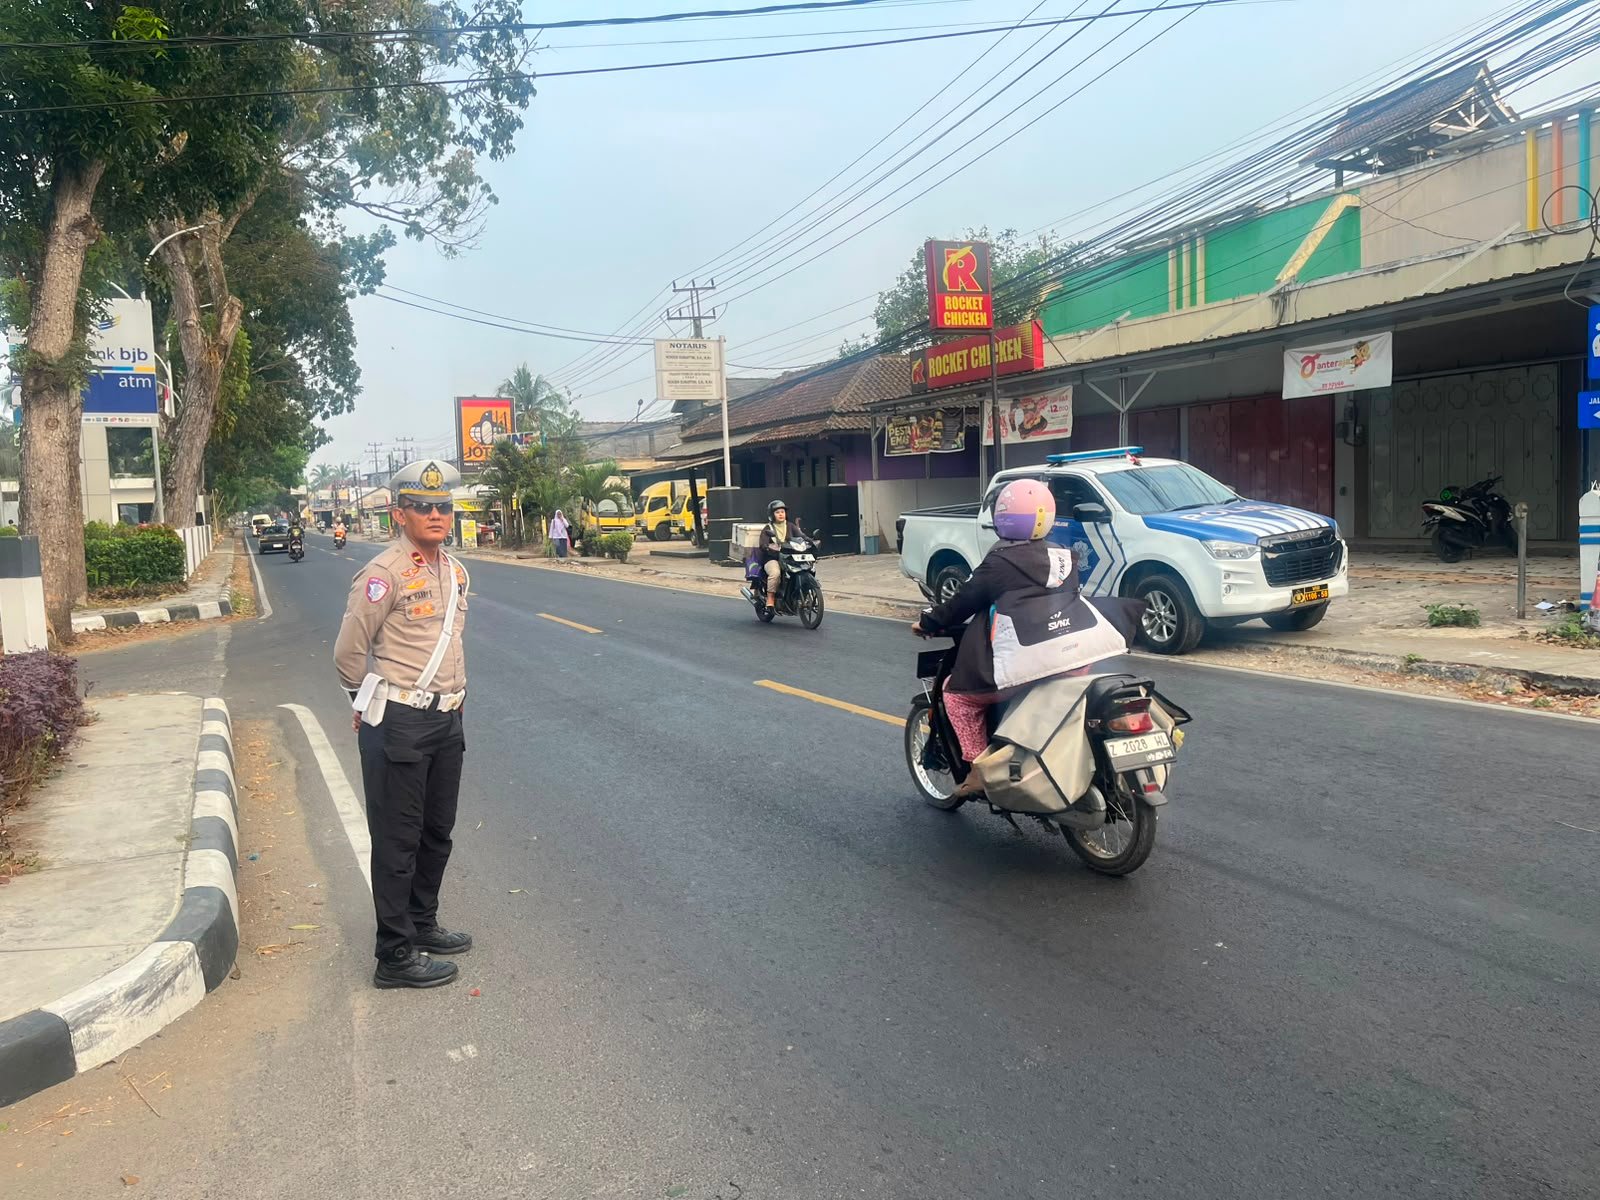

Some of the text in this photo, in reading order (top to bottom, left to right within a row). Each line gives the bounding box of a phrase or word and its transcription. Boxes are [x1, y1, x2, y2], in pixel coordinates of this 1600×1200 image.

[945, 296, 983, 310] ROCKET
[943, 311, 987, 326] CHICKEN
[120, 347, 148, 363] bjb
[928, 337, 1022, 378] ROCKET CHICKEN
[119, 375, 152, 388] atm
[888, 425, 912, 438] PESTA
[464, 447, 491, 458] JOT
[1110, 745, 1117, 755] Z
[1123, 738, 1148, 753] 2028
